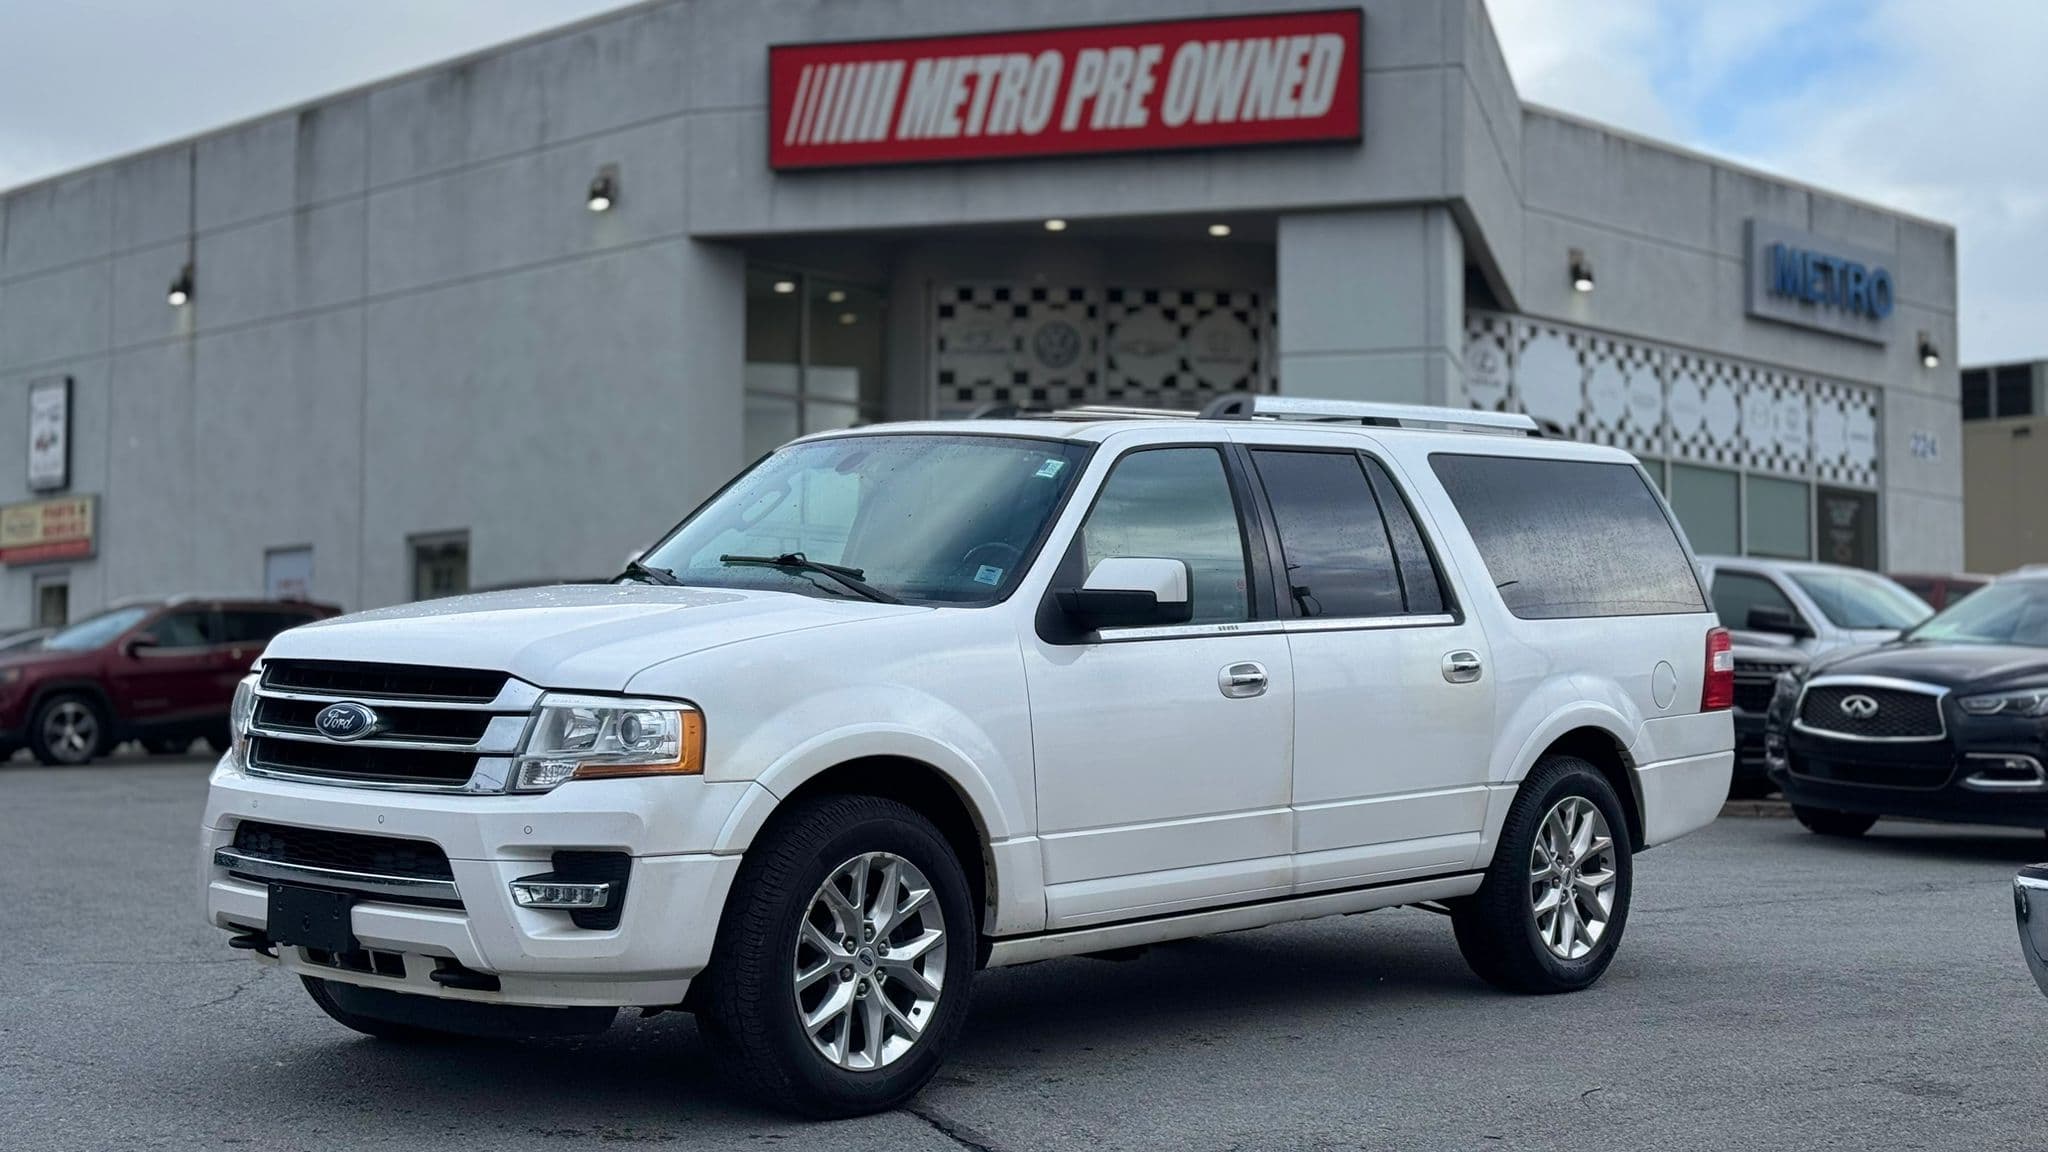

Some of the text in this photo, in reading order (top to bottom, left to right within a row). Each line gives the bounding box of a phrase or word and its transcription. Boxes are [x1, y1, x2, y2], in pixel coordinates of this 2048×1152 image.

[896, 33, 1345, 140] METRO PRE OWNED
[1770, 243, 1893, 318] METRO
[1910, 432, 1937, 457] 224
[323, 708, 355, 729] Ford
